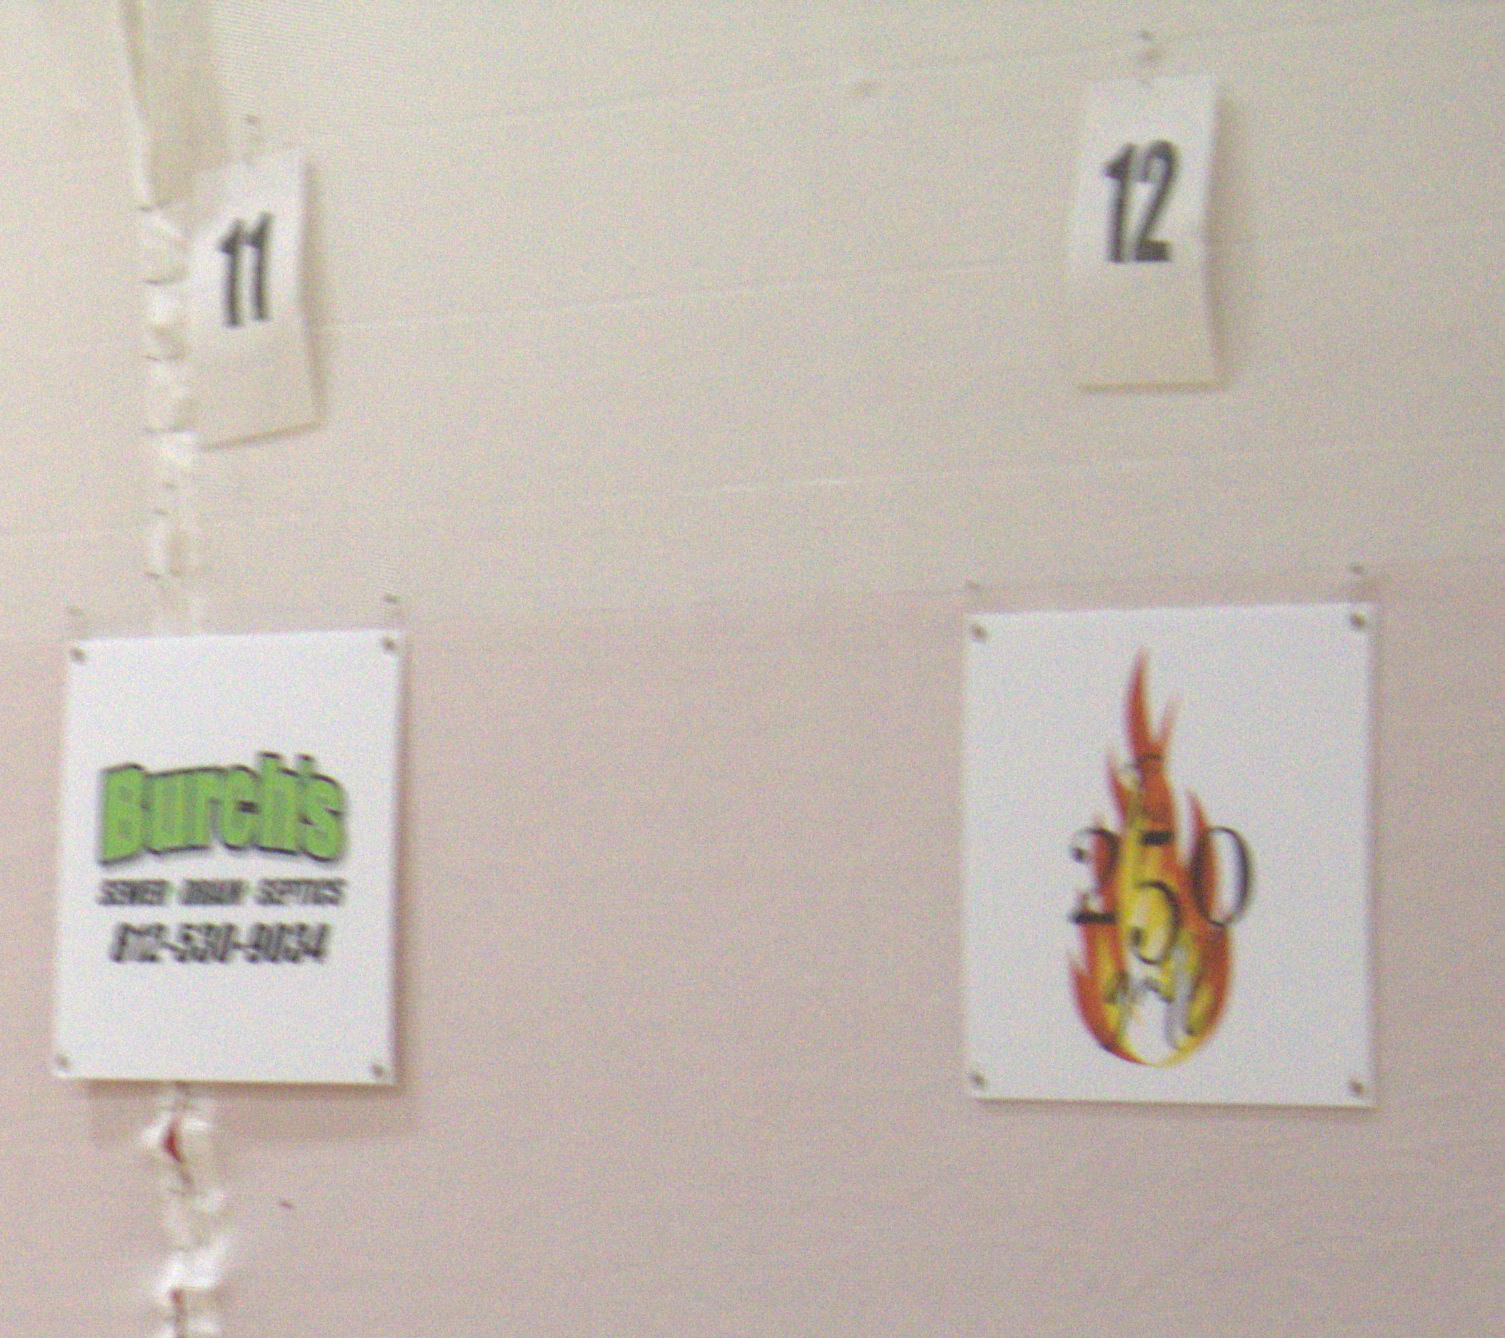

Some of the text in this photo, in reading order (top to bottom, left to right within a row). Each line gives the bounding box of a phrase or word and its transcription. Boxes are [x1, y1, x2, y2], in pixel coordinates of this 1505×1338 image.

[1103, 139, 1177, 262] 12
[217, 211, 274, 328] 11
[96, 750, 347, 868] Burch's
